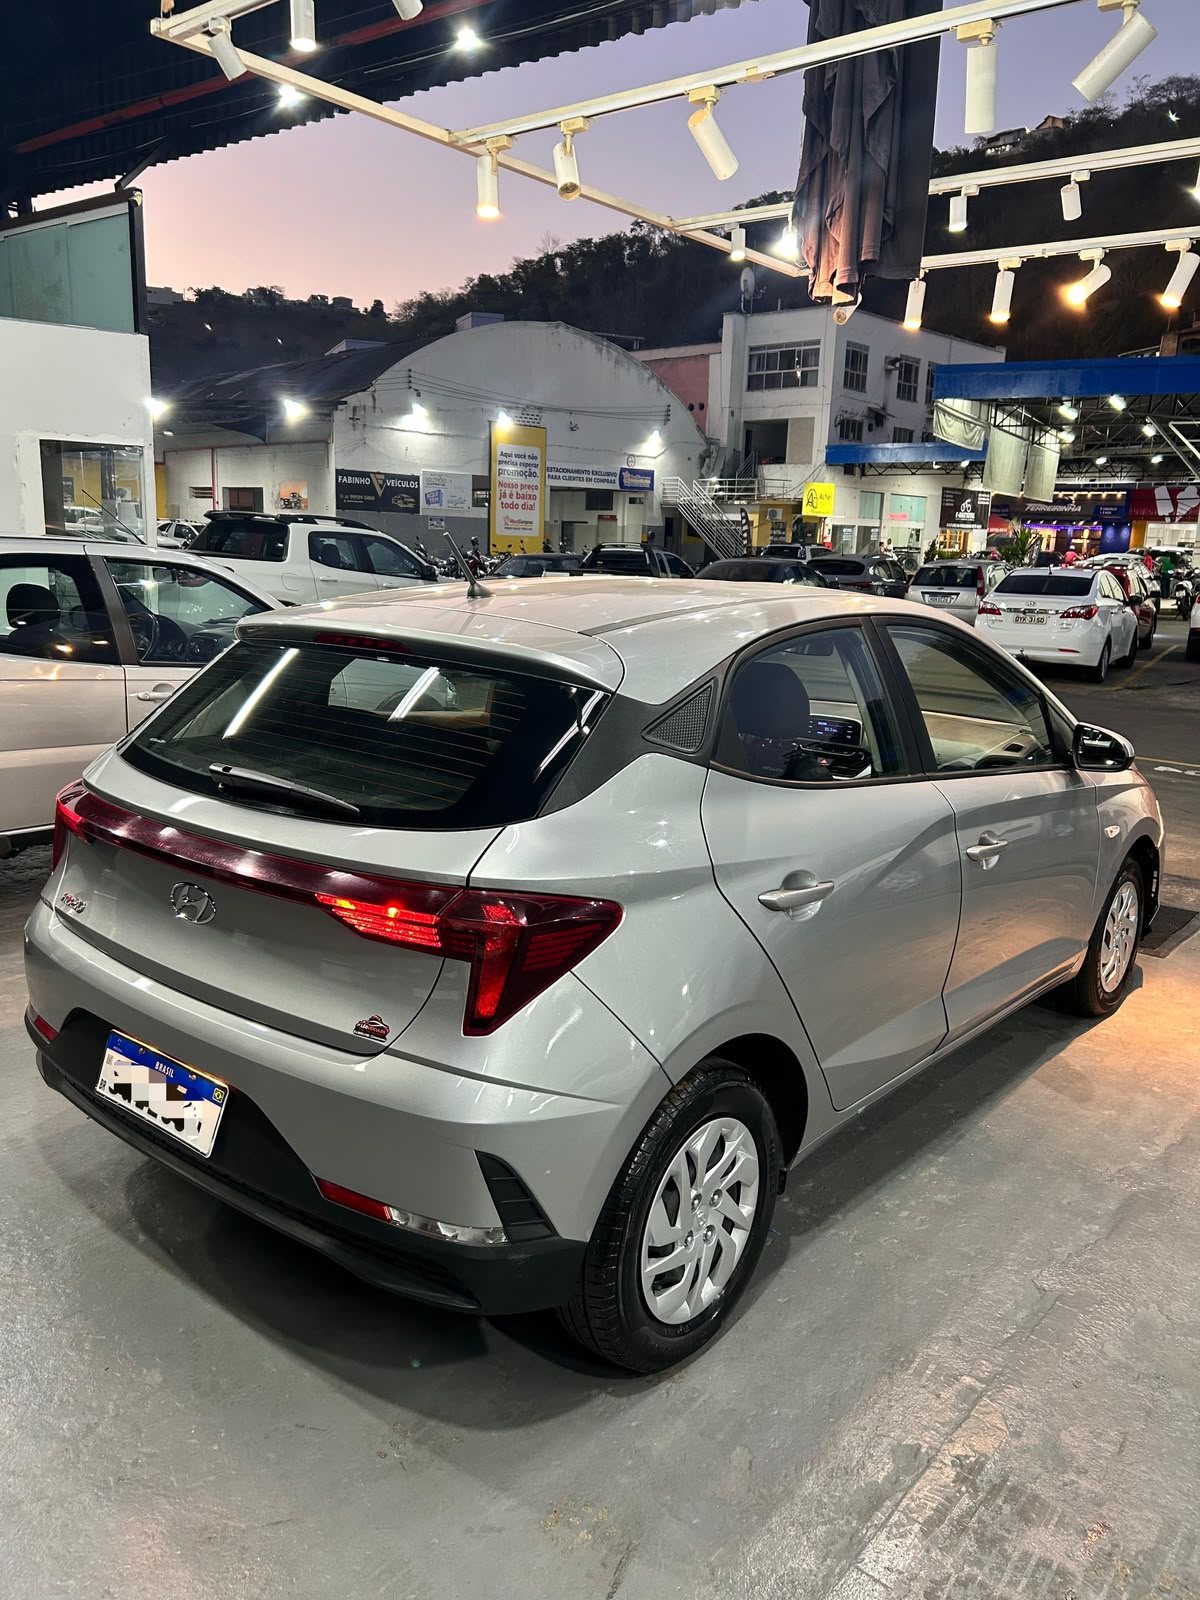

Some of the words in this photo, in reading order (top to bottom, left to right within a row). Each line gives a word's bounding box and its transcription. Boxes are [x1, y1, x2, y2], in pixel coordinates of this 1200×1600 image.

[500, 451, 513, 459] Aqui
[514, 452, 526, 460] você
[498, 468, 539, 480] promoção.
[546, 466, 590, 476] ESTACIONAMENTO
[592, 470, 618, 478] EXCLUSIVO
[338, 476, 371, 485] FABINHO
[498, 480, 518, 489] Nosso
[498, 489, 506, 500] já
[508, 491, 514, 499] é
[516, 491, 537, 500] baixo
[501, 500, 519, 510] todo
[521, 502, 536, 511] dia!
[154, 1061, 174, 1078] BRASIL
